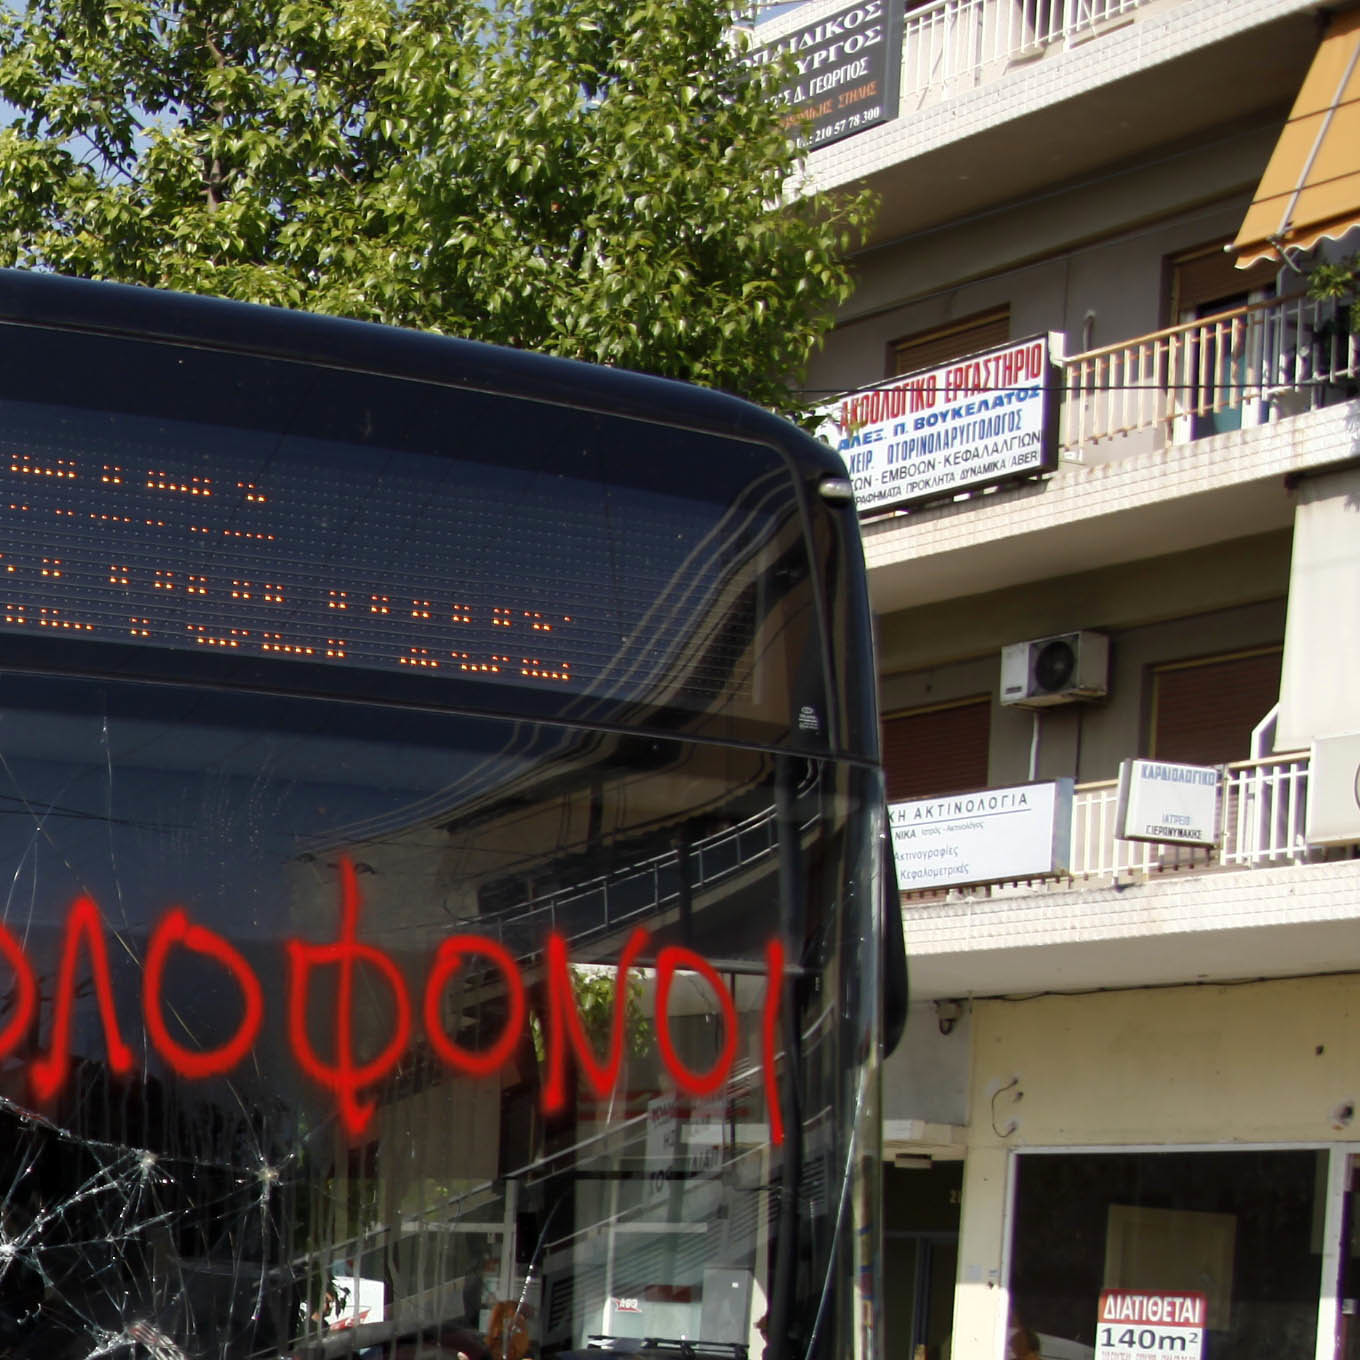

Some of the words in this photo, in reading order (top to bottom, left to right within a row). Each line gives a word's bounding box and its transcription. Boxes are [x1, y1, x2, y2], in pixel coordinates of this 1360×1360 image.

[809, 56, 870, 97] ΓΕΩΡΓΙΟΣ
[815, 126, 831, 142] 210
[833, 119, 846, 135] 57
[848, 113, 860, 128] 78
[862, 106, 880, 123] 300
[944, 343, 1042, 404] ΕΡΓΑΣΤΗΡΙΟ
[913, 383, 1041, 432] ΒΟΥΚΕΛΑΤΟΣ
[881, 459, 936, 484] ΕΜΒΟΩΝ
[943, 430, 1041, 467] ΚΕΦΑΛΑΛΓΙΩΝ
[855, 485, 902, 506] ΡΑΦΗΜΑΤΑ
[906, 472, 955, 494] ΠΡΟΚΛΗΤΑ
[959, 459, 1006, 481] ΔΥΝΑΜΙΚΑ
[913, 792, 1028, 819] ΑΚΤΙΝΟΛΟΓΙΑ
[1103, 1294, 1201, 1324] ΔΙΑΤΙΘΕΤΑΙ
